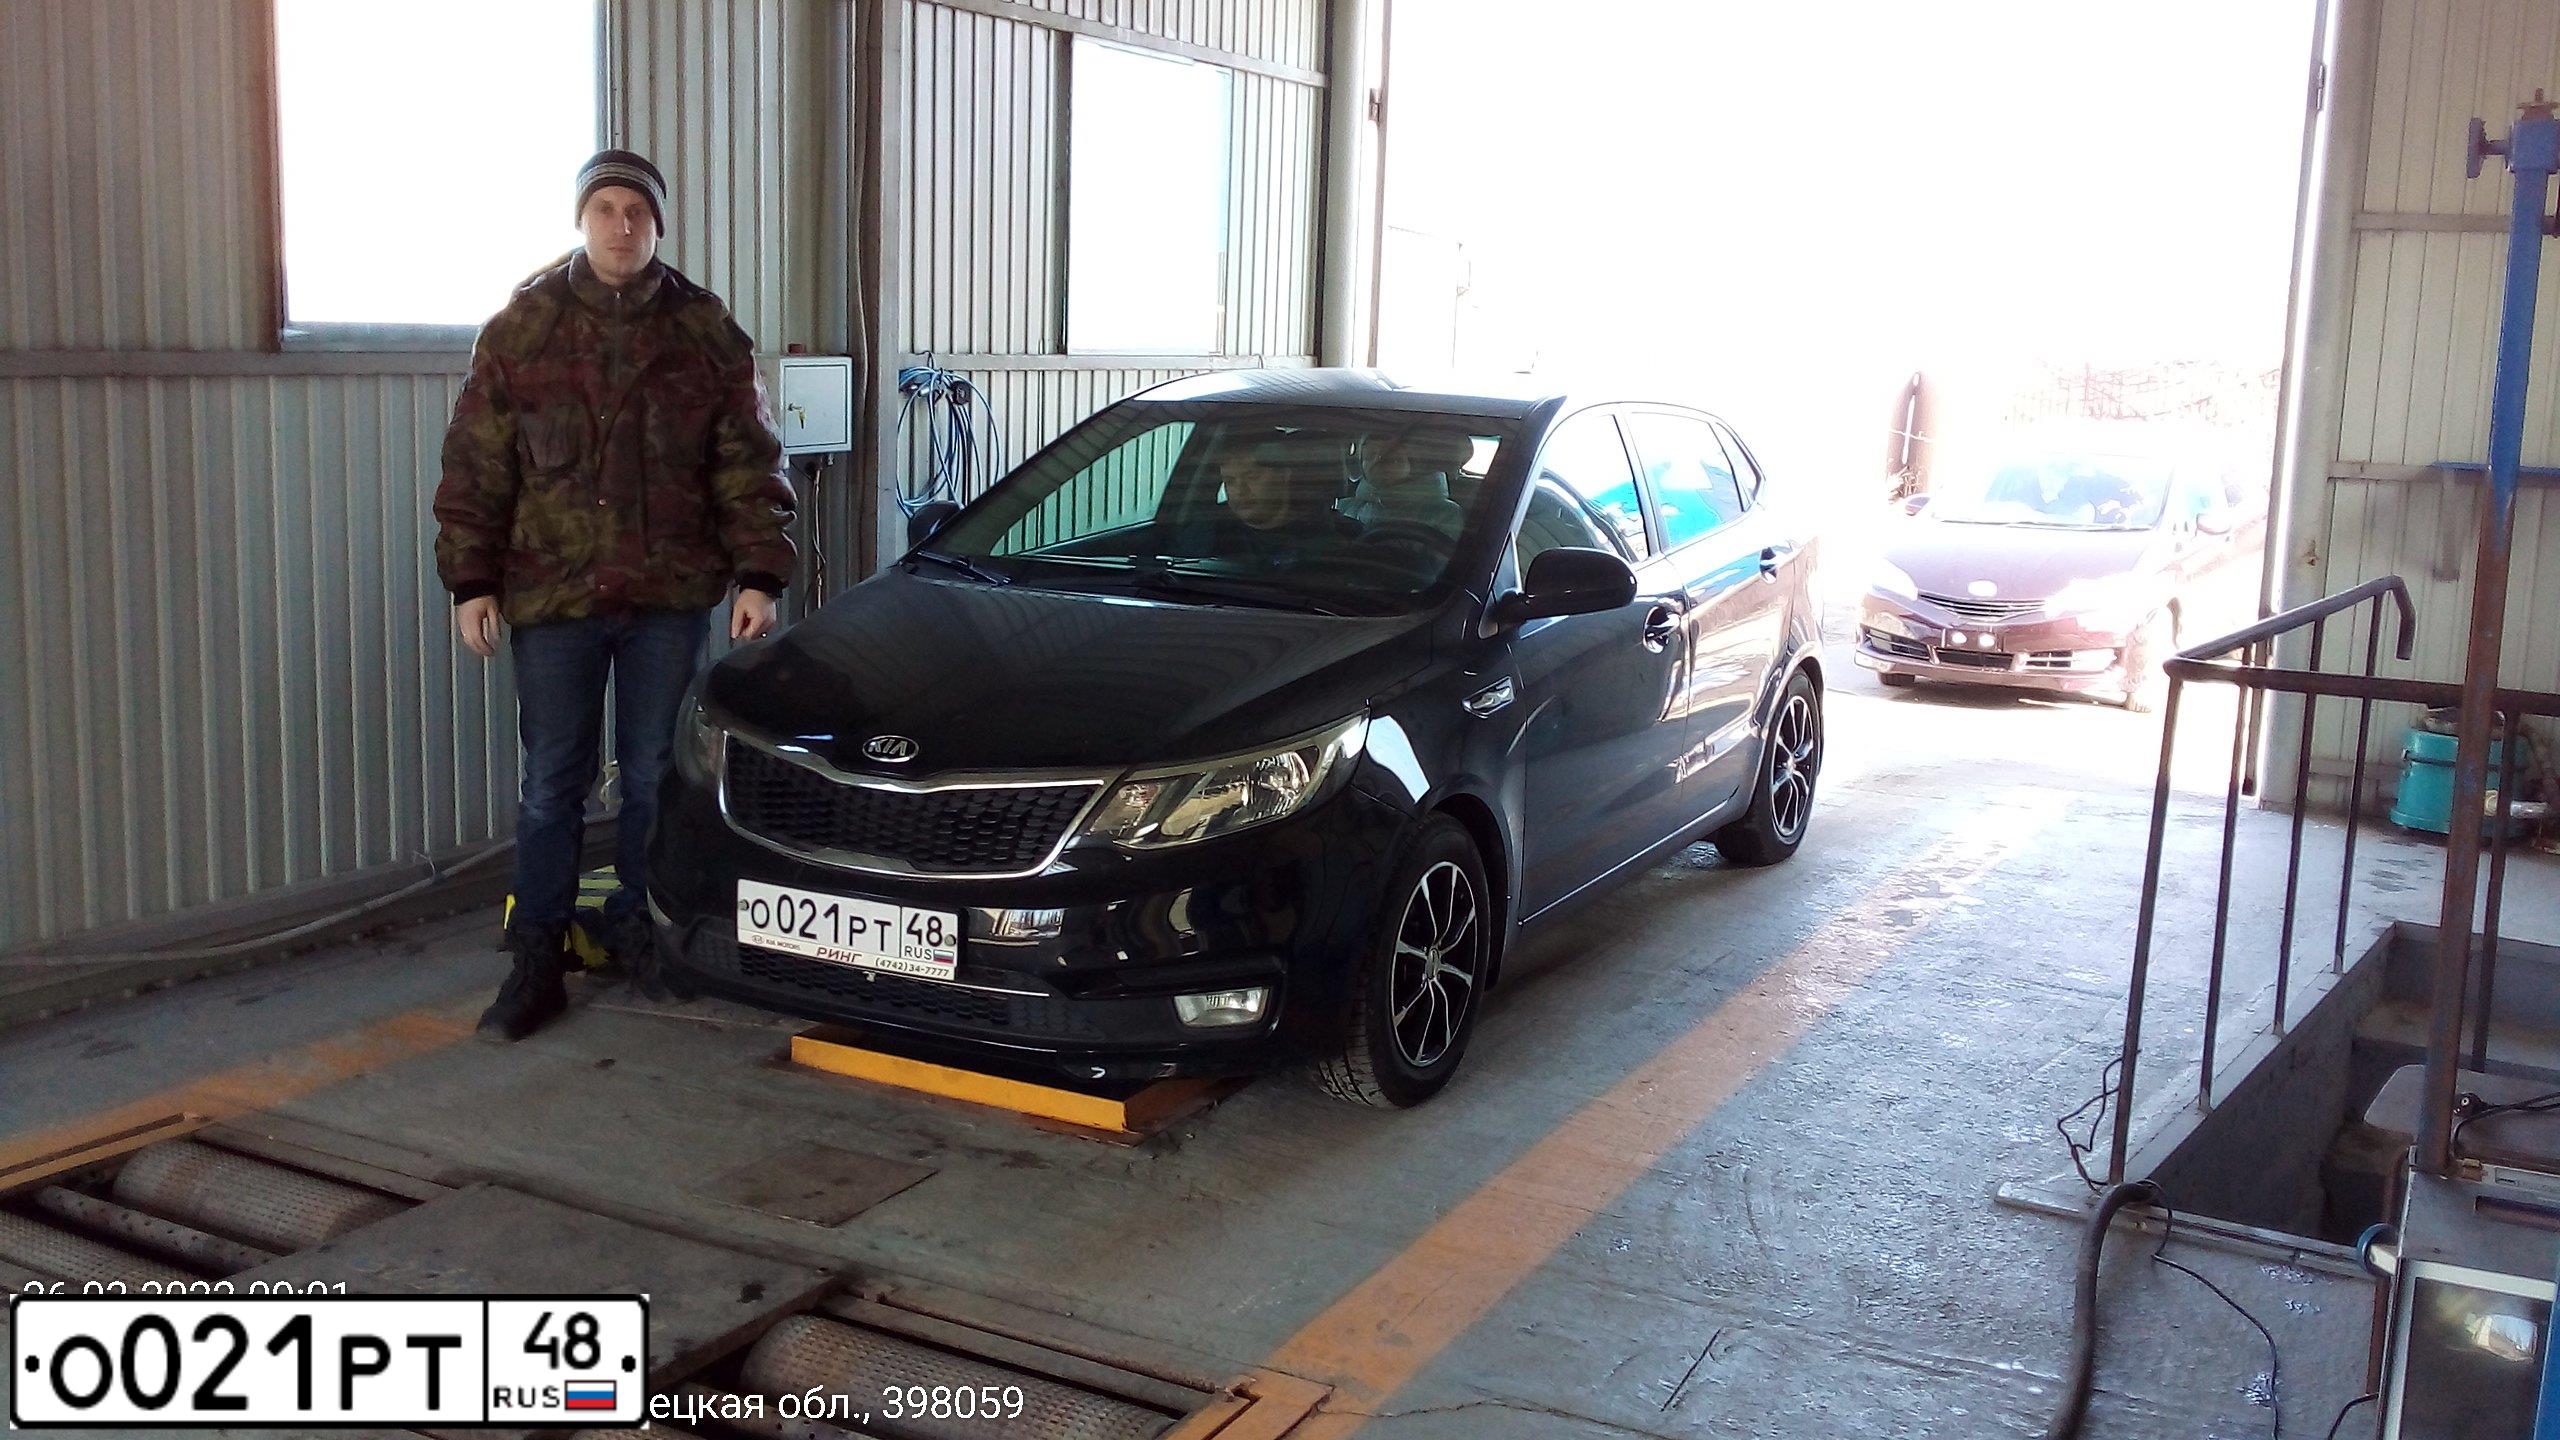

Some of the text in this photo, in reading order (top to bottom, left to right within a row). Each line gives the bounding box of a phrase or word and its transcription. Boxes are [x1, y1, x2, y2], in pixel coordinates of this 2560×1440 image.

[868, 739, 908, 756] KIA
[750, 894, 943, 952] О021РТ 48
[817, 947, 863, 963] РИНГ
[904, 946, 932, 960] RUS
